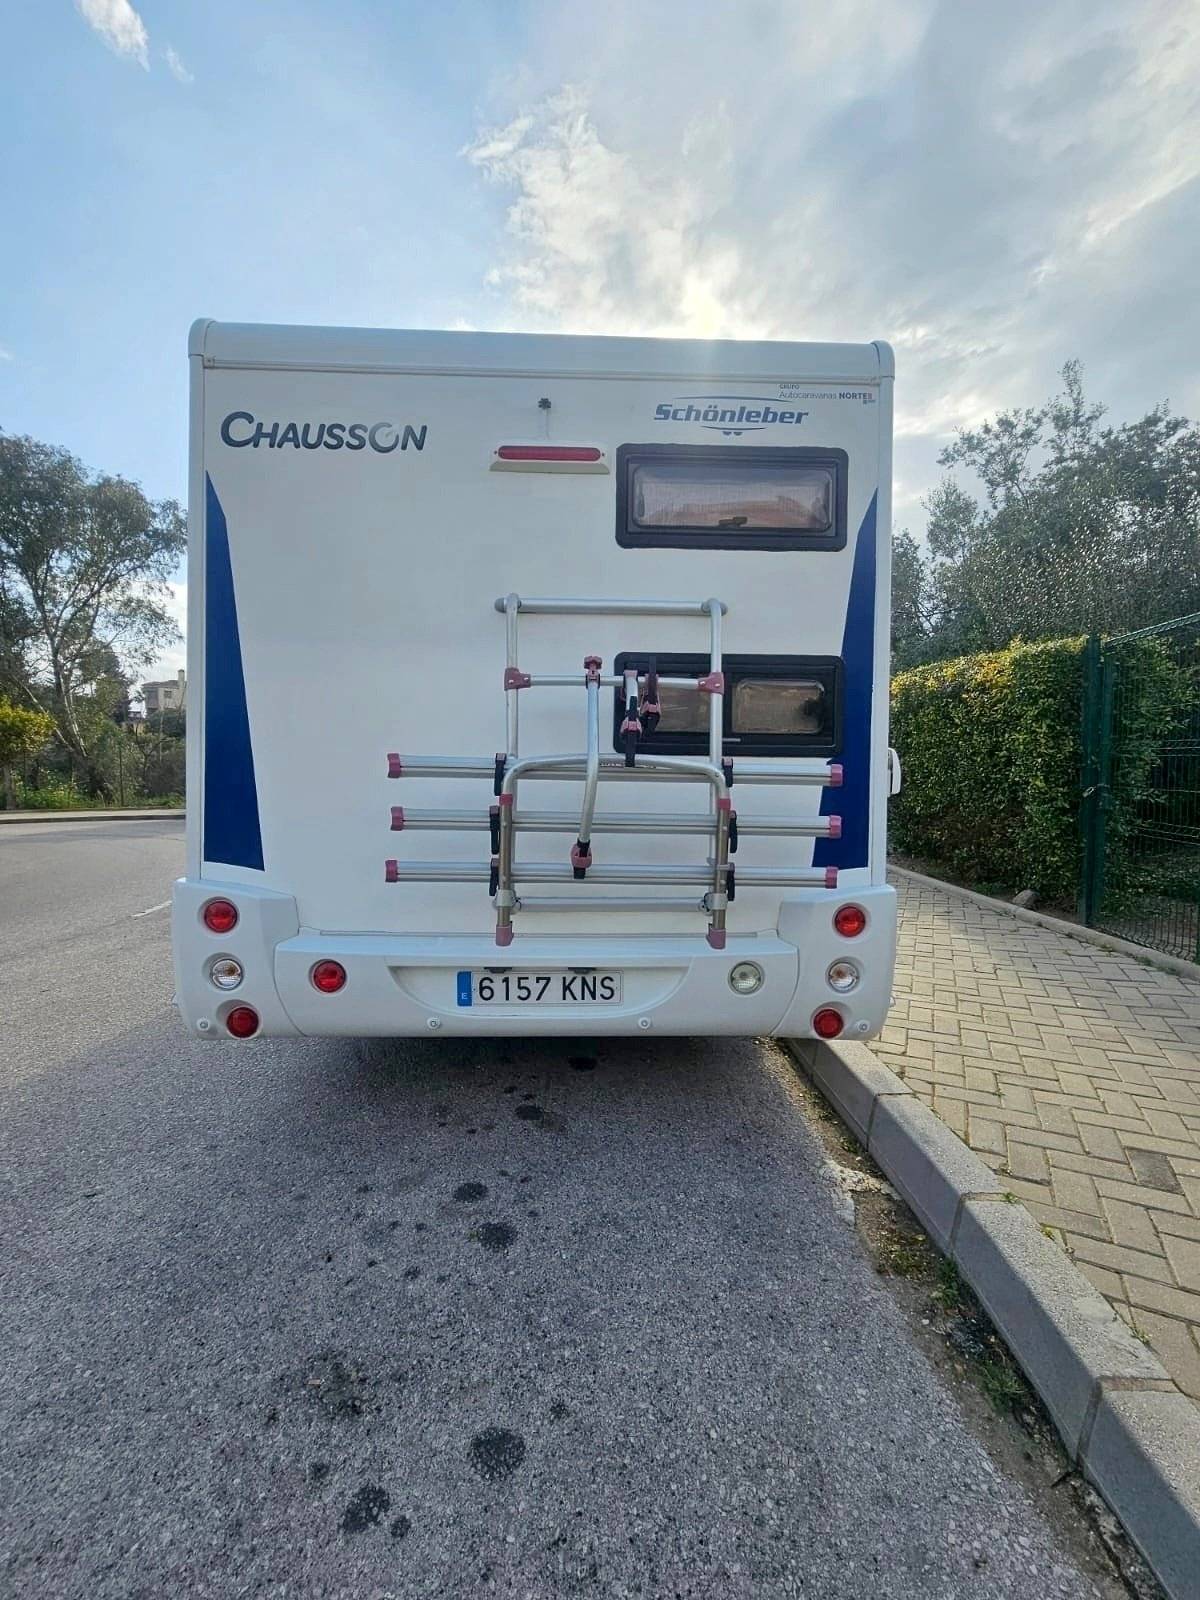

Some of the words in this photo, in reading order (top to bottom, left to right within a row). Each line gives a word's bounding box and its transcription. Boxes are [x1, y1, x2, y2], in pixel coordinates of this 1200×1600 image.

[779, 391, 837, 399] Autocaravanas
[654, 404, 809, 424] Schönleber
[220, 411, 428, 453] CHAUSSON
[478, 976, 551, 1001] 6157
[562, 975, 615, 1001] KNS
